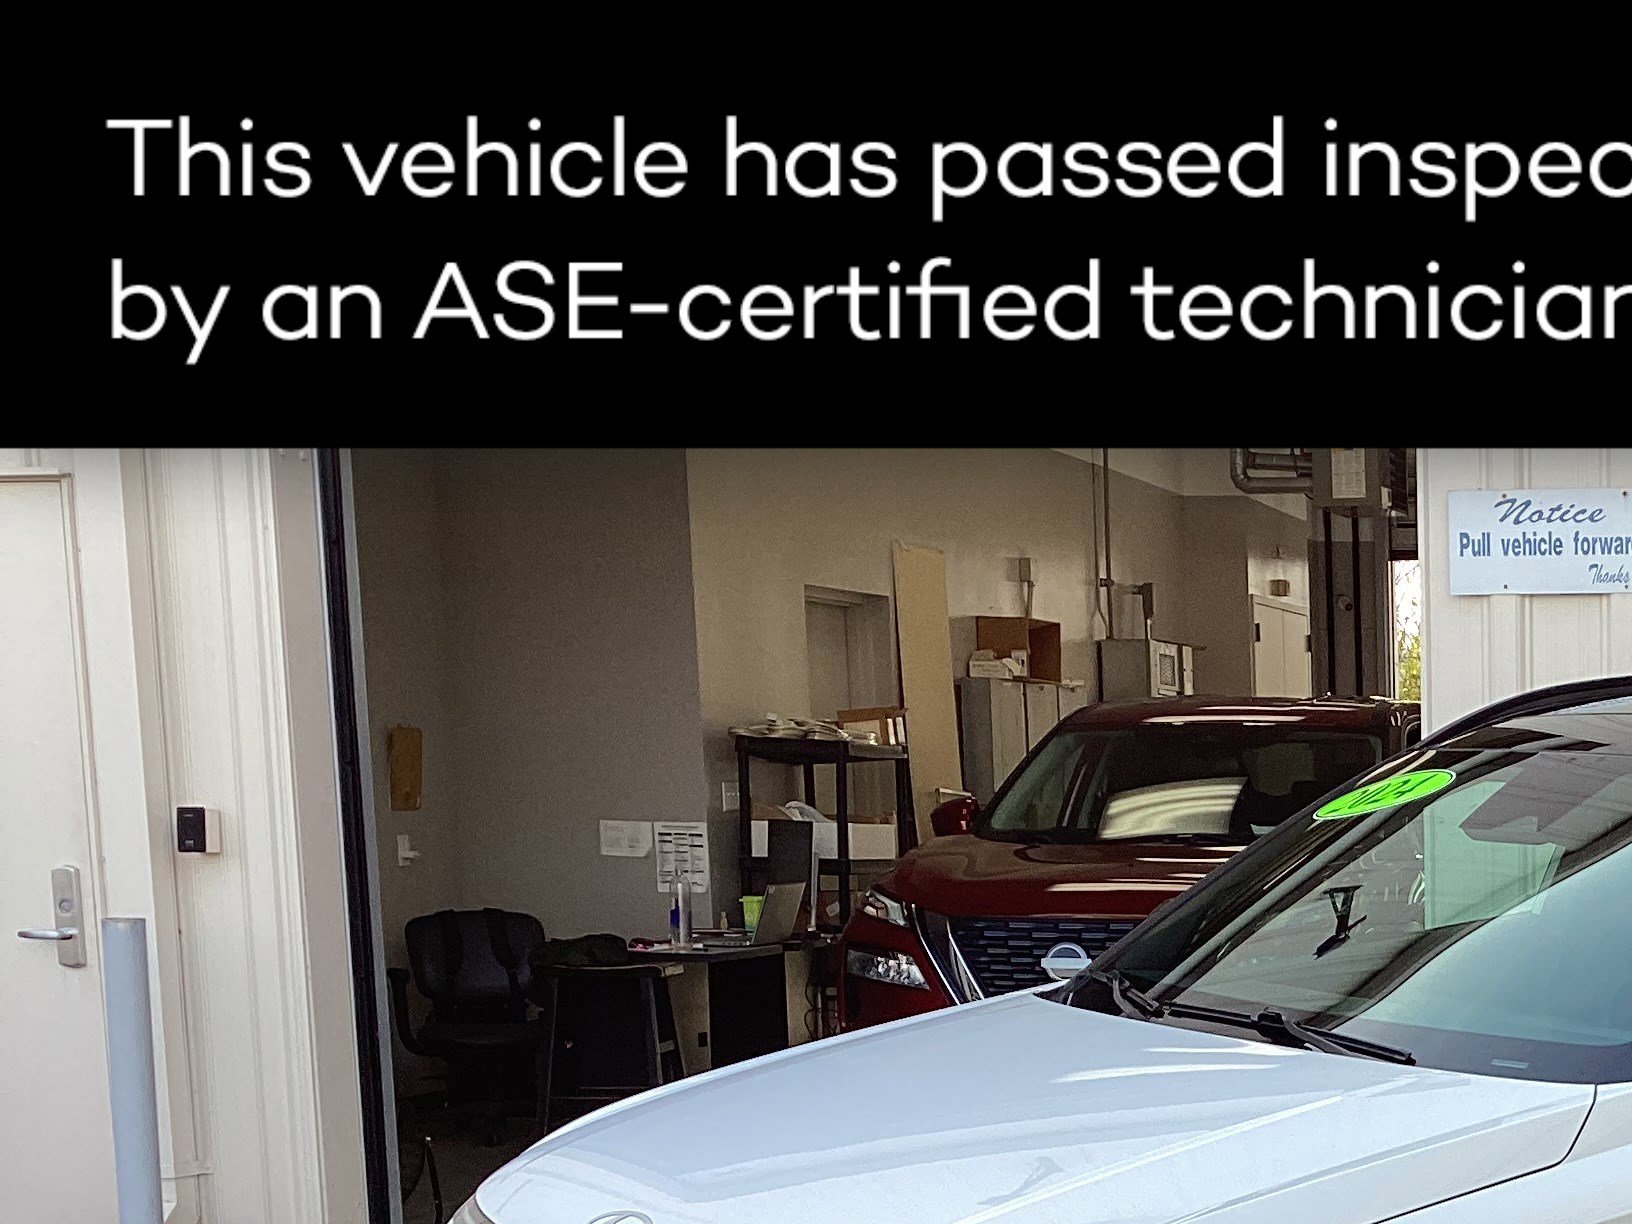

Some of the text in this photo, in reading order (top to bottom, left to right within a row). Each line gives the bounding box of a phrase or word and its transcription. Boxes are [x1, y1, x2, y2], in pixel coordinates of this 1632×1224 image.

[1494, 497, 1607, 526] Notice
[1459, 532, 1491, 557] Pull
[1501, 531, 1563, 556] vehicle
[1588, 563, 1630, 585] Thanks
[1325, 773, 1439, 815] 2024
